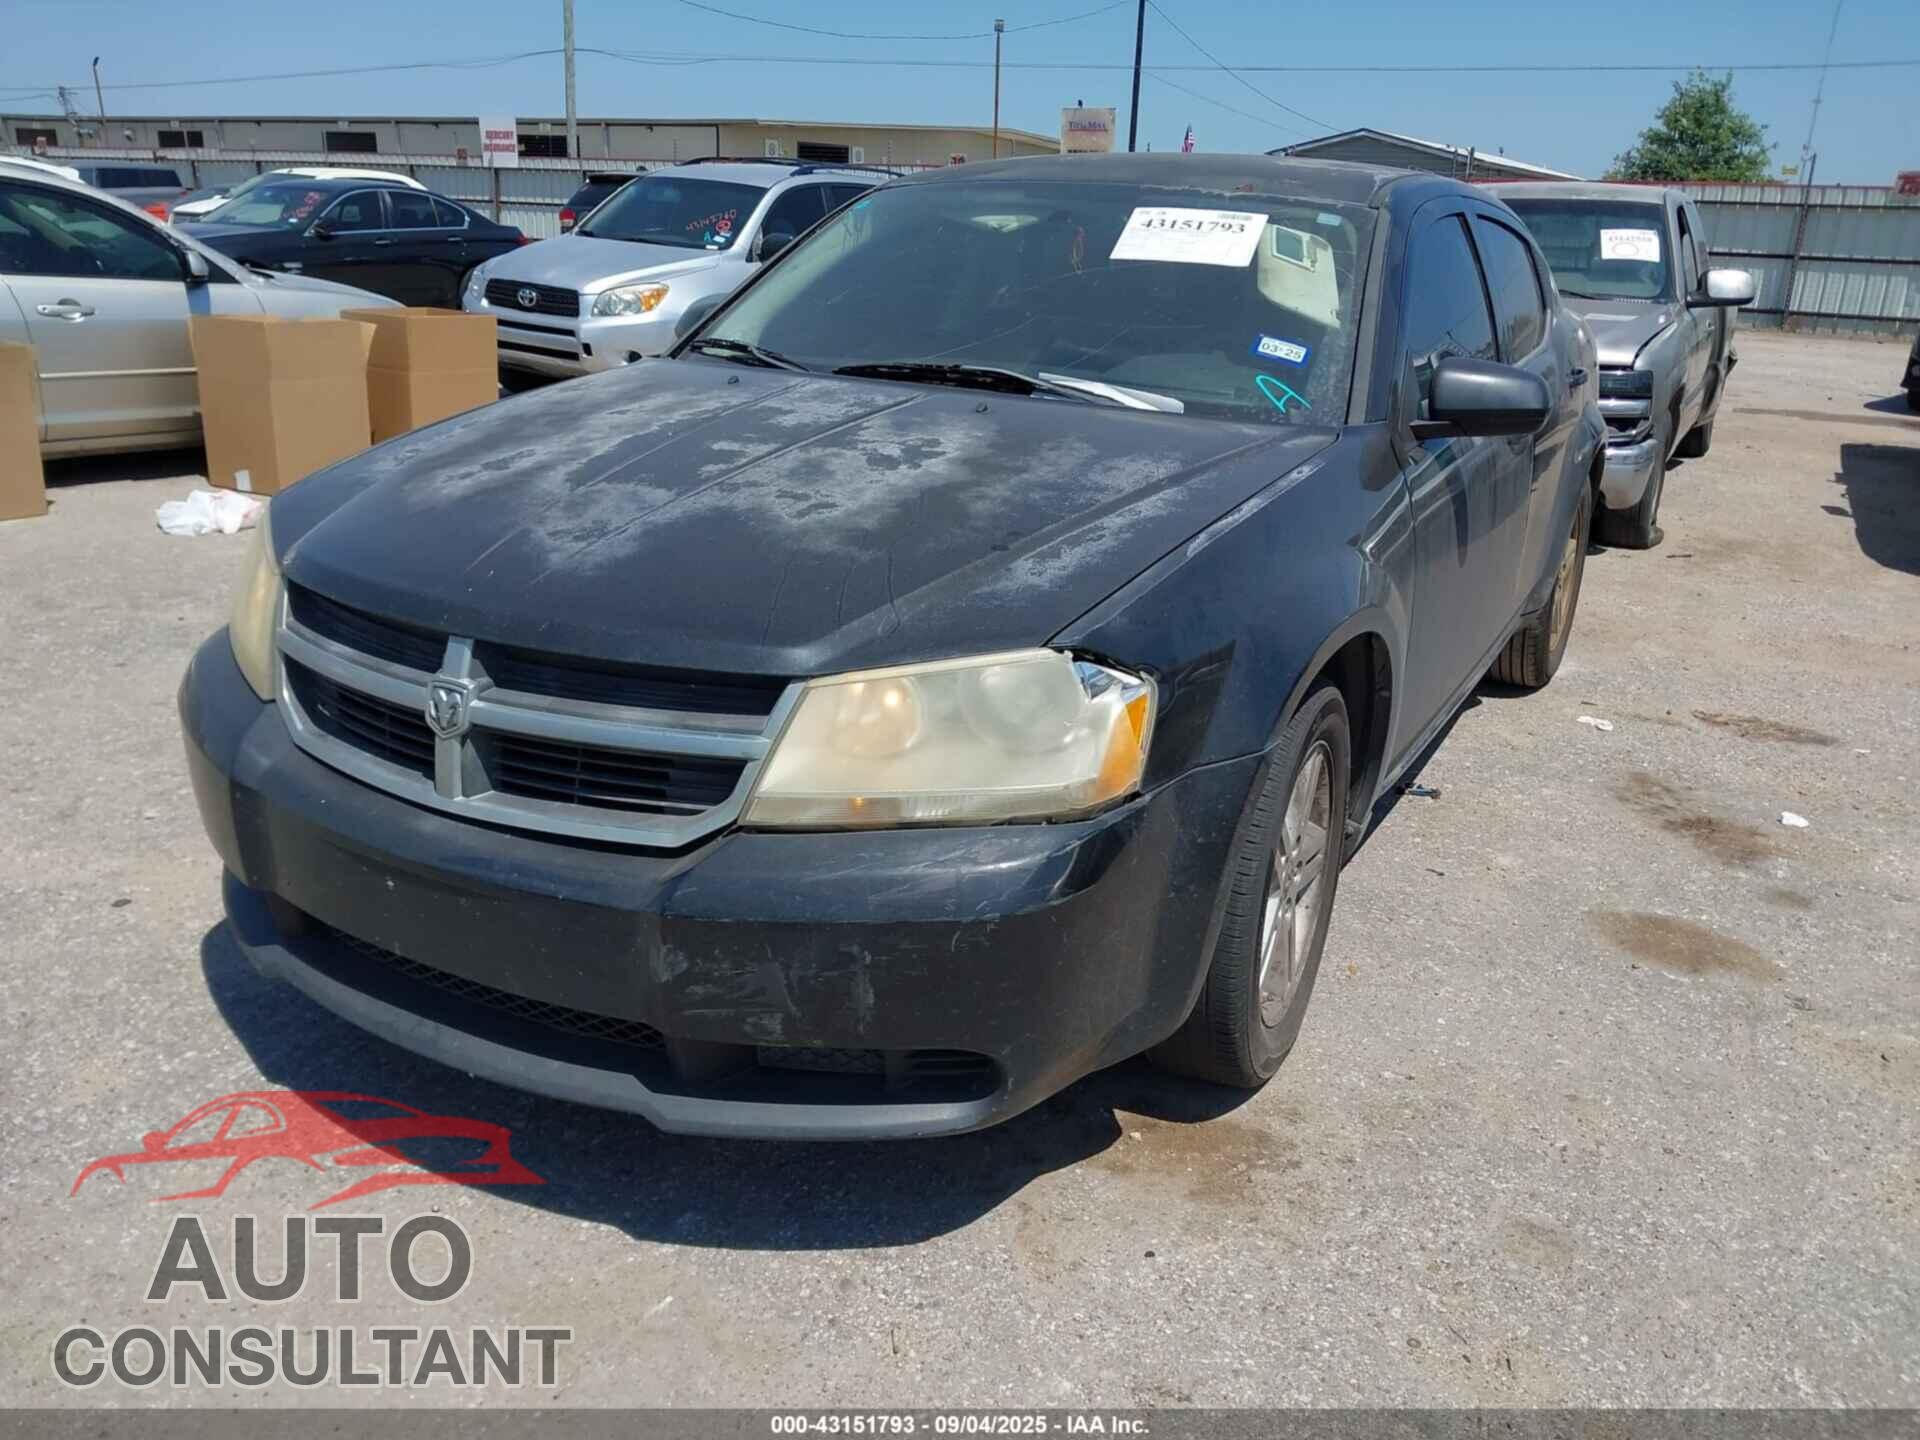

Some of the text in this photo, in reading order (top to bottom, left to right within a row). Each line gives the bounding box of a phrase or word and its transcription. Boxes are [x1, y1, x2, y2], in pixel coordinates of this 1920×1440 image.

[1140, 218, 1246, 234] 43151793
[1261, 342, 1302, 360] 03 25
